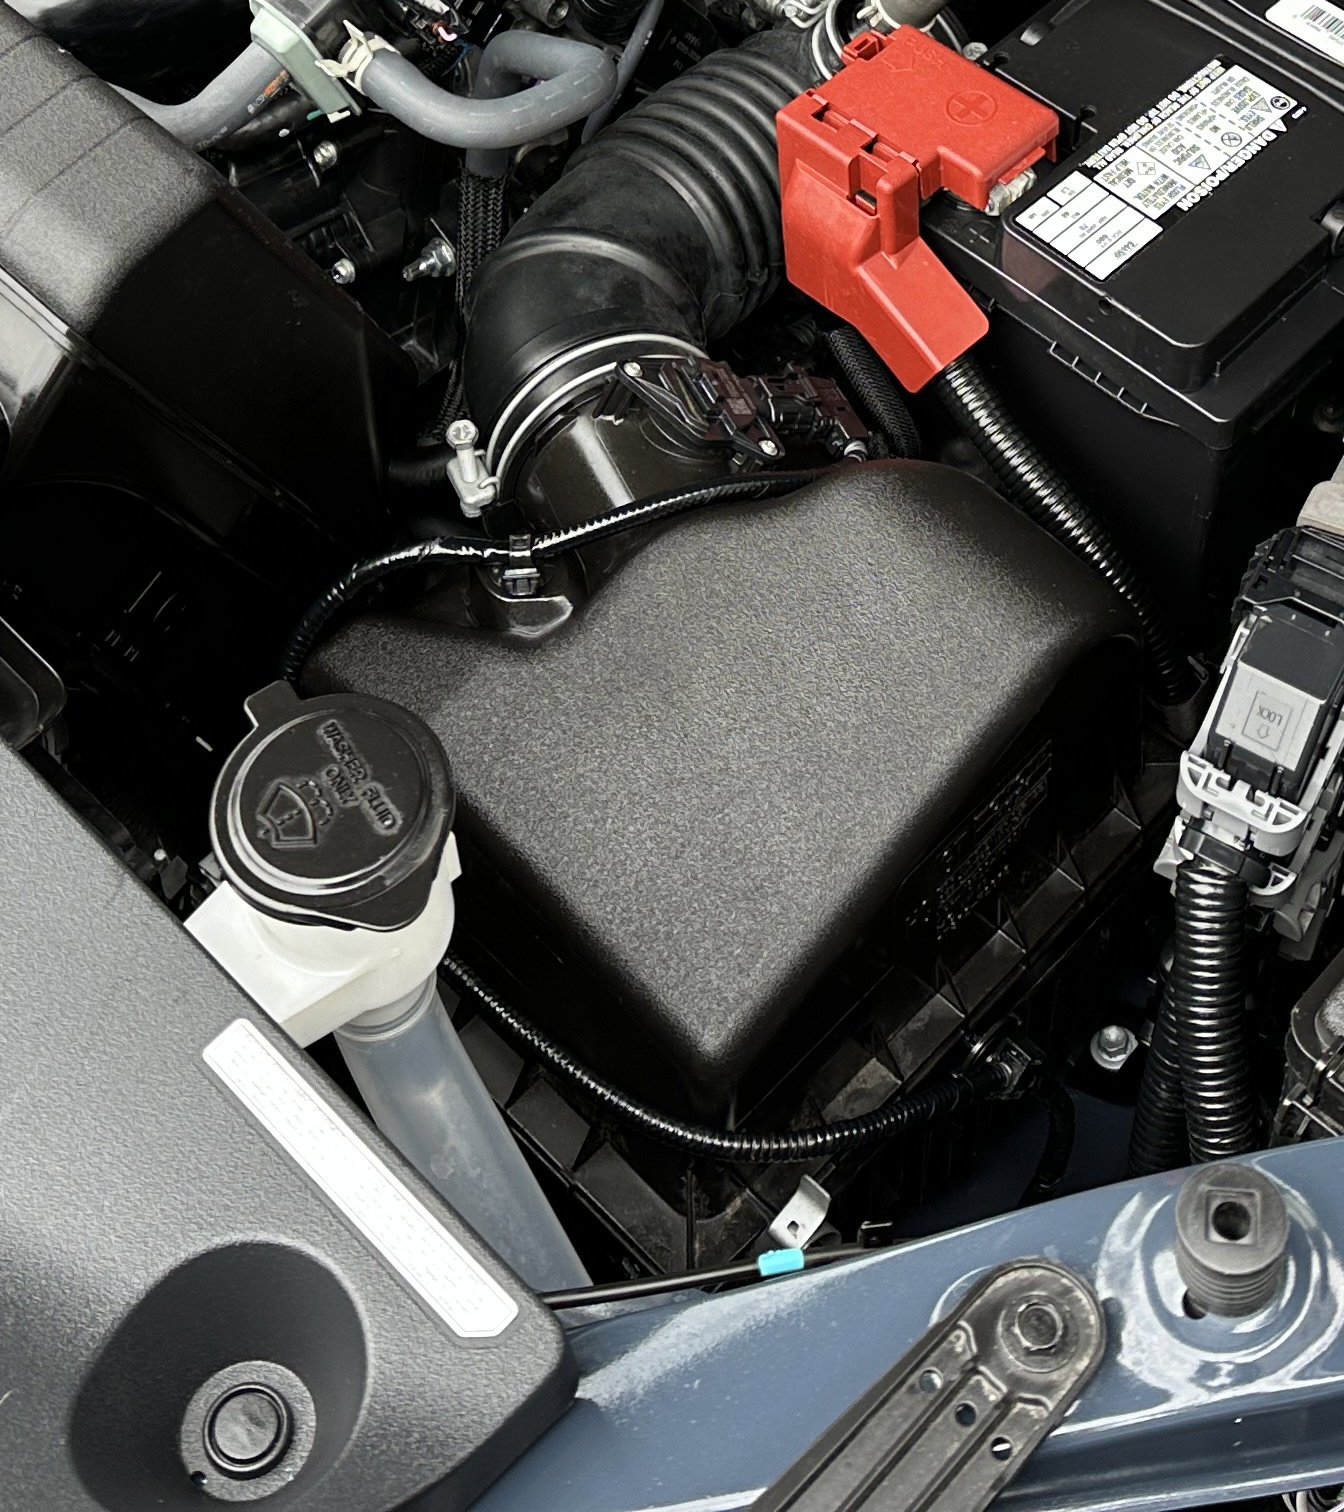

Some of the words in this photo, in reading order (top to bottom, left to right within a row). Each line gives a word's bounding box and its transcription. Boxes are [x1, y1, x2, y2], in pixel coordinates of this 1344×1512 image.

[1173, 128, 1278, 211] DANGER/POISON
[1257, 705, 1283, 726] LOCK
[323, 722, 368, 784] WASHER
[362, 786, 396, 829] FLUID
[326, 768, 358, 804] ONLY
